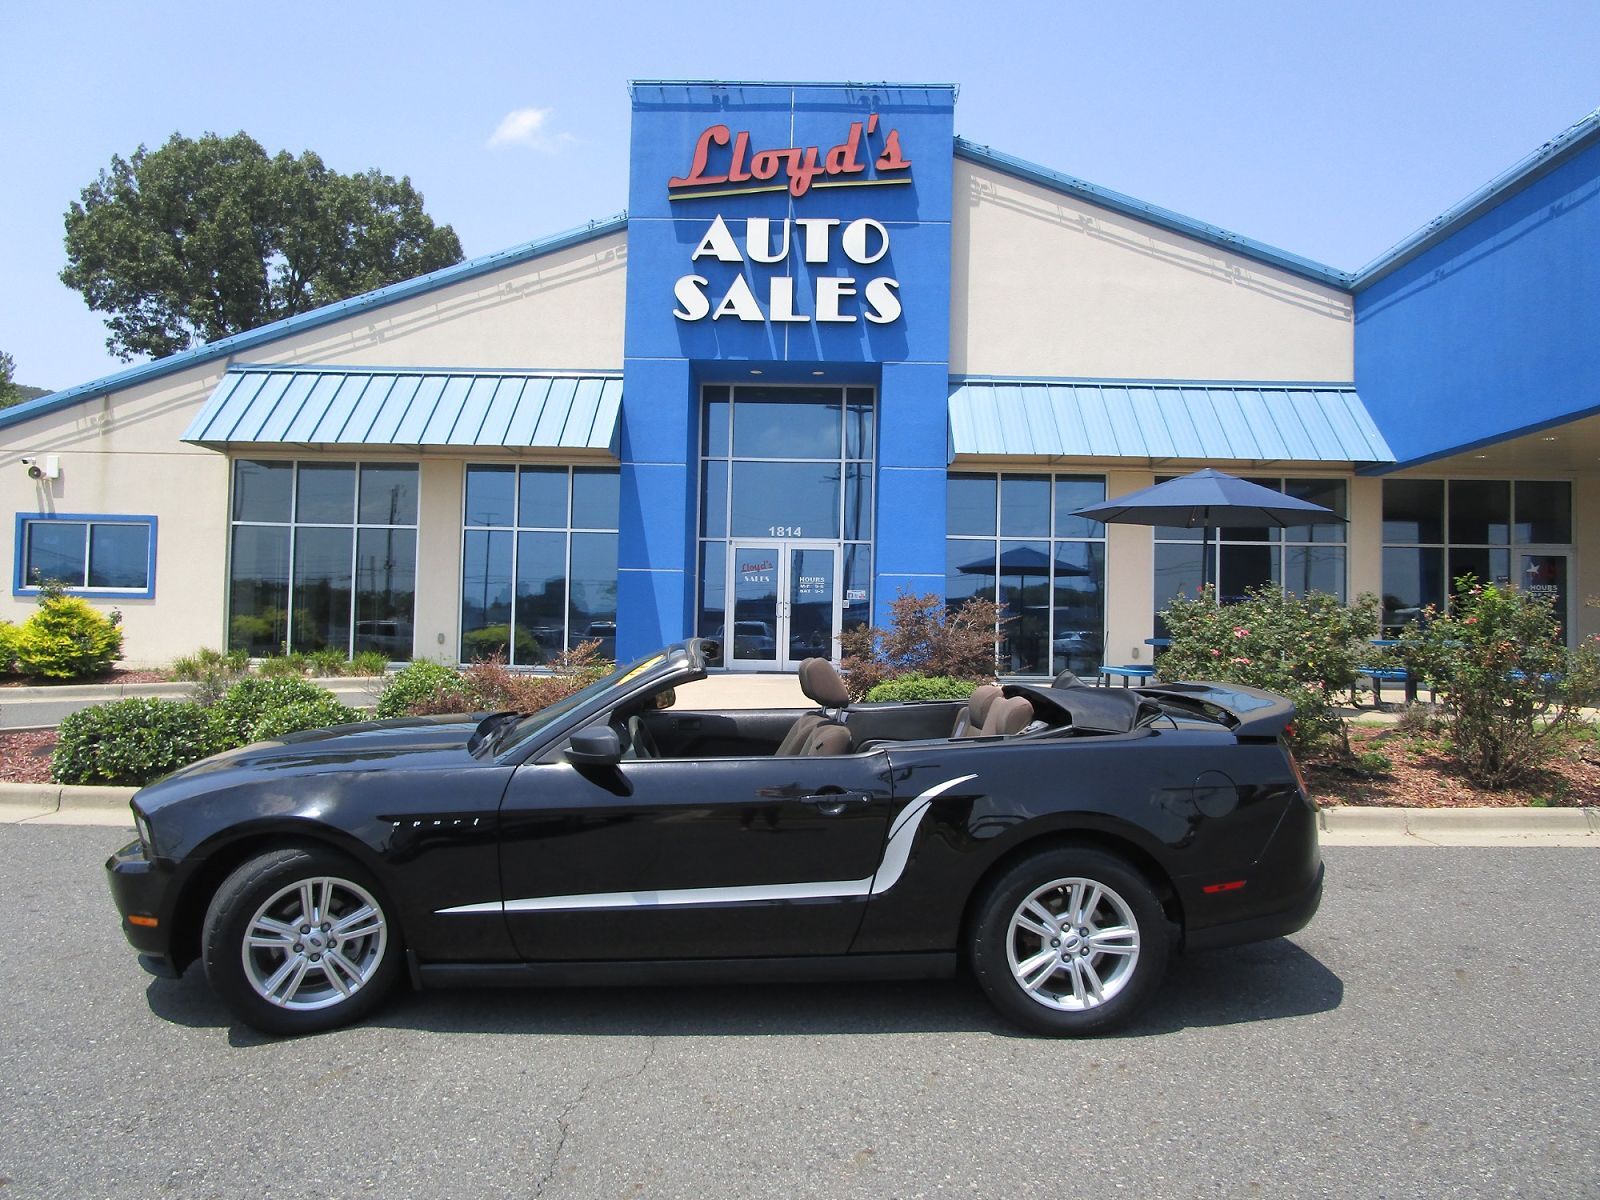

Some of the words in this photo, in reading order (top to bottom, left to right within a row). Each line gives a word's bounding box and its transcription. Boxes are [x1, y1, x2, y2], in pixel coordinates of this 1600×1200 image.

[668, 113, 912, 197] Lloyd's
[691, 213, 890, 264] AUTO
[672, 273, 902, 324] SALES
[769, 526, 802, 537] 1814
